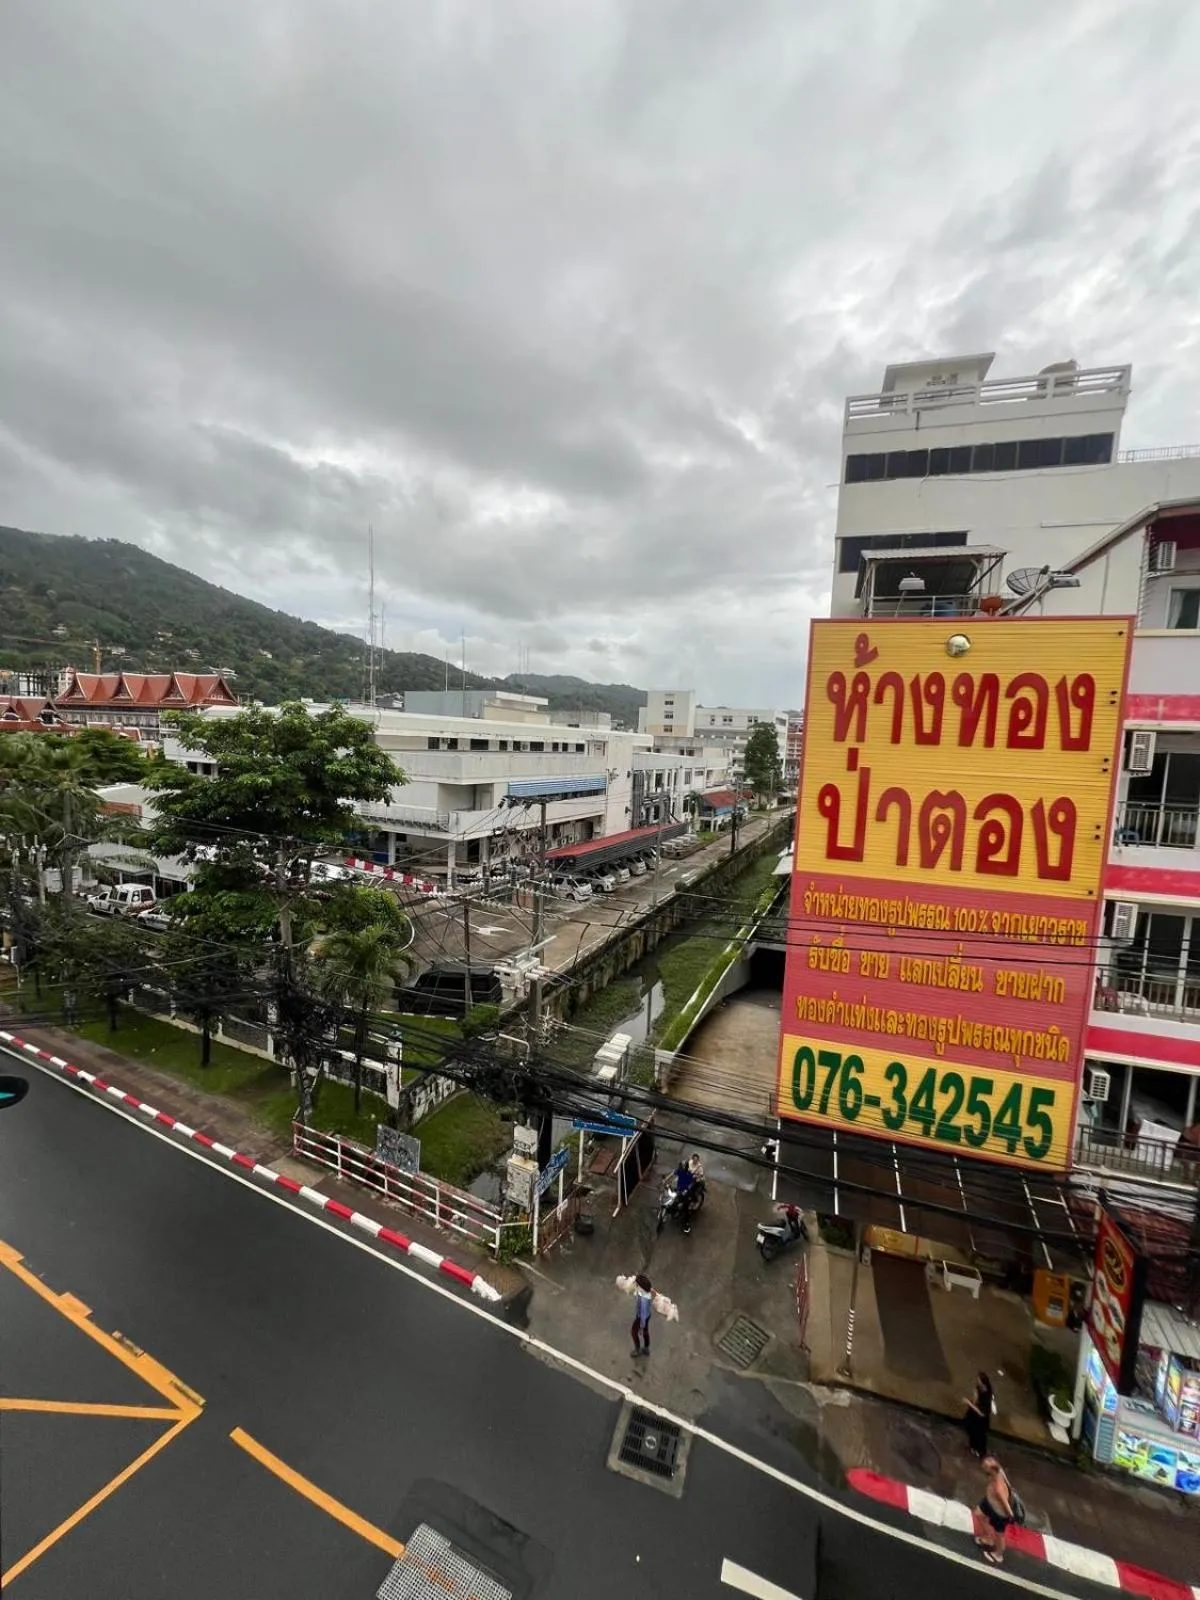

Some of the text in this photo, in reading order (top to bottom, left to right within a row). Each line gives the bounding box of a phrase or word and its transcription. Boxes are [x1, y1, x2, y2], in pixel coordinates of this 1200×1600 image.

[827, 633, 1096, 751] ห้างทอง
[818, 747, 1077, 881] ป่าตอง
[860, 951, 890, 979] ขาย
[995, 968, 1065, 1004] ขายฝาก
[791, 1045, 1056, 1160] 076-342545
